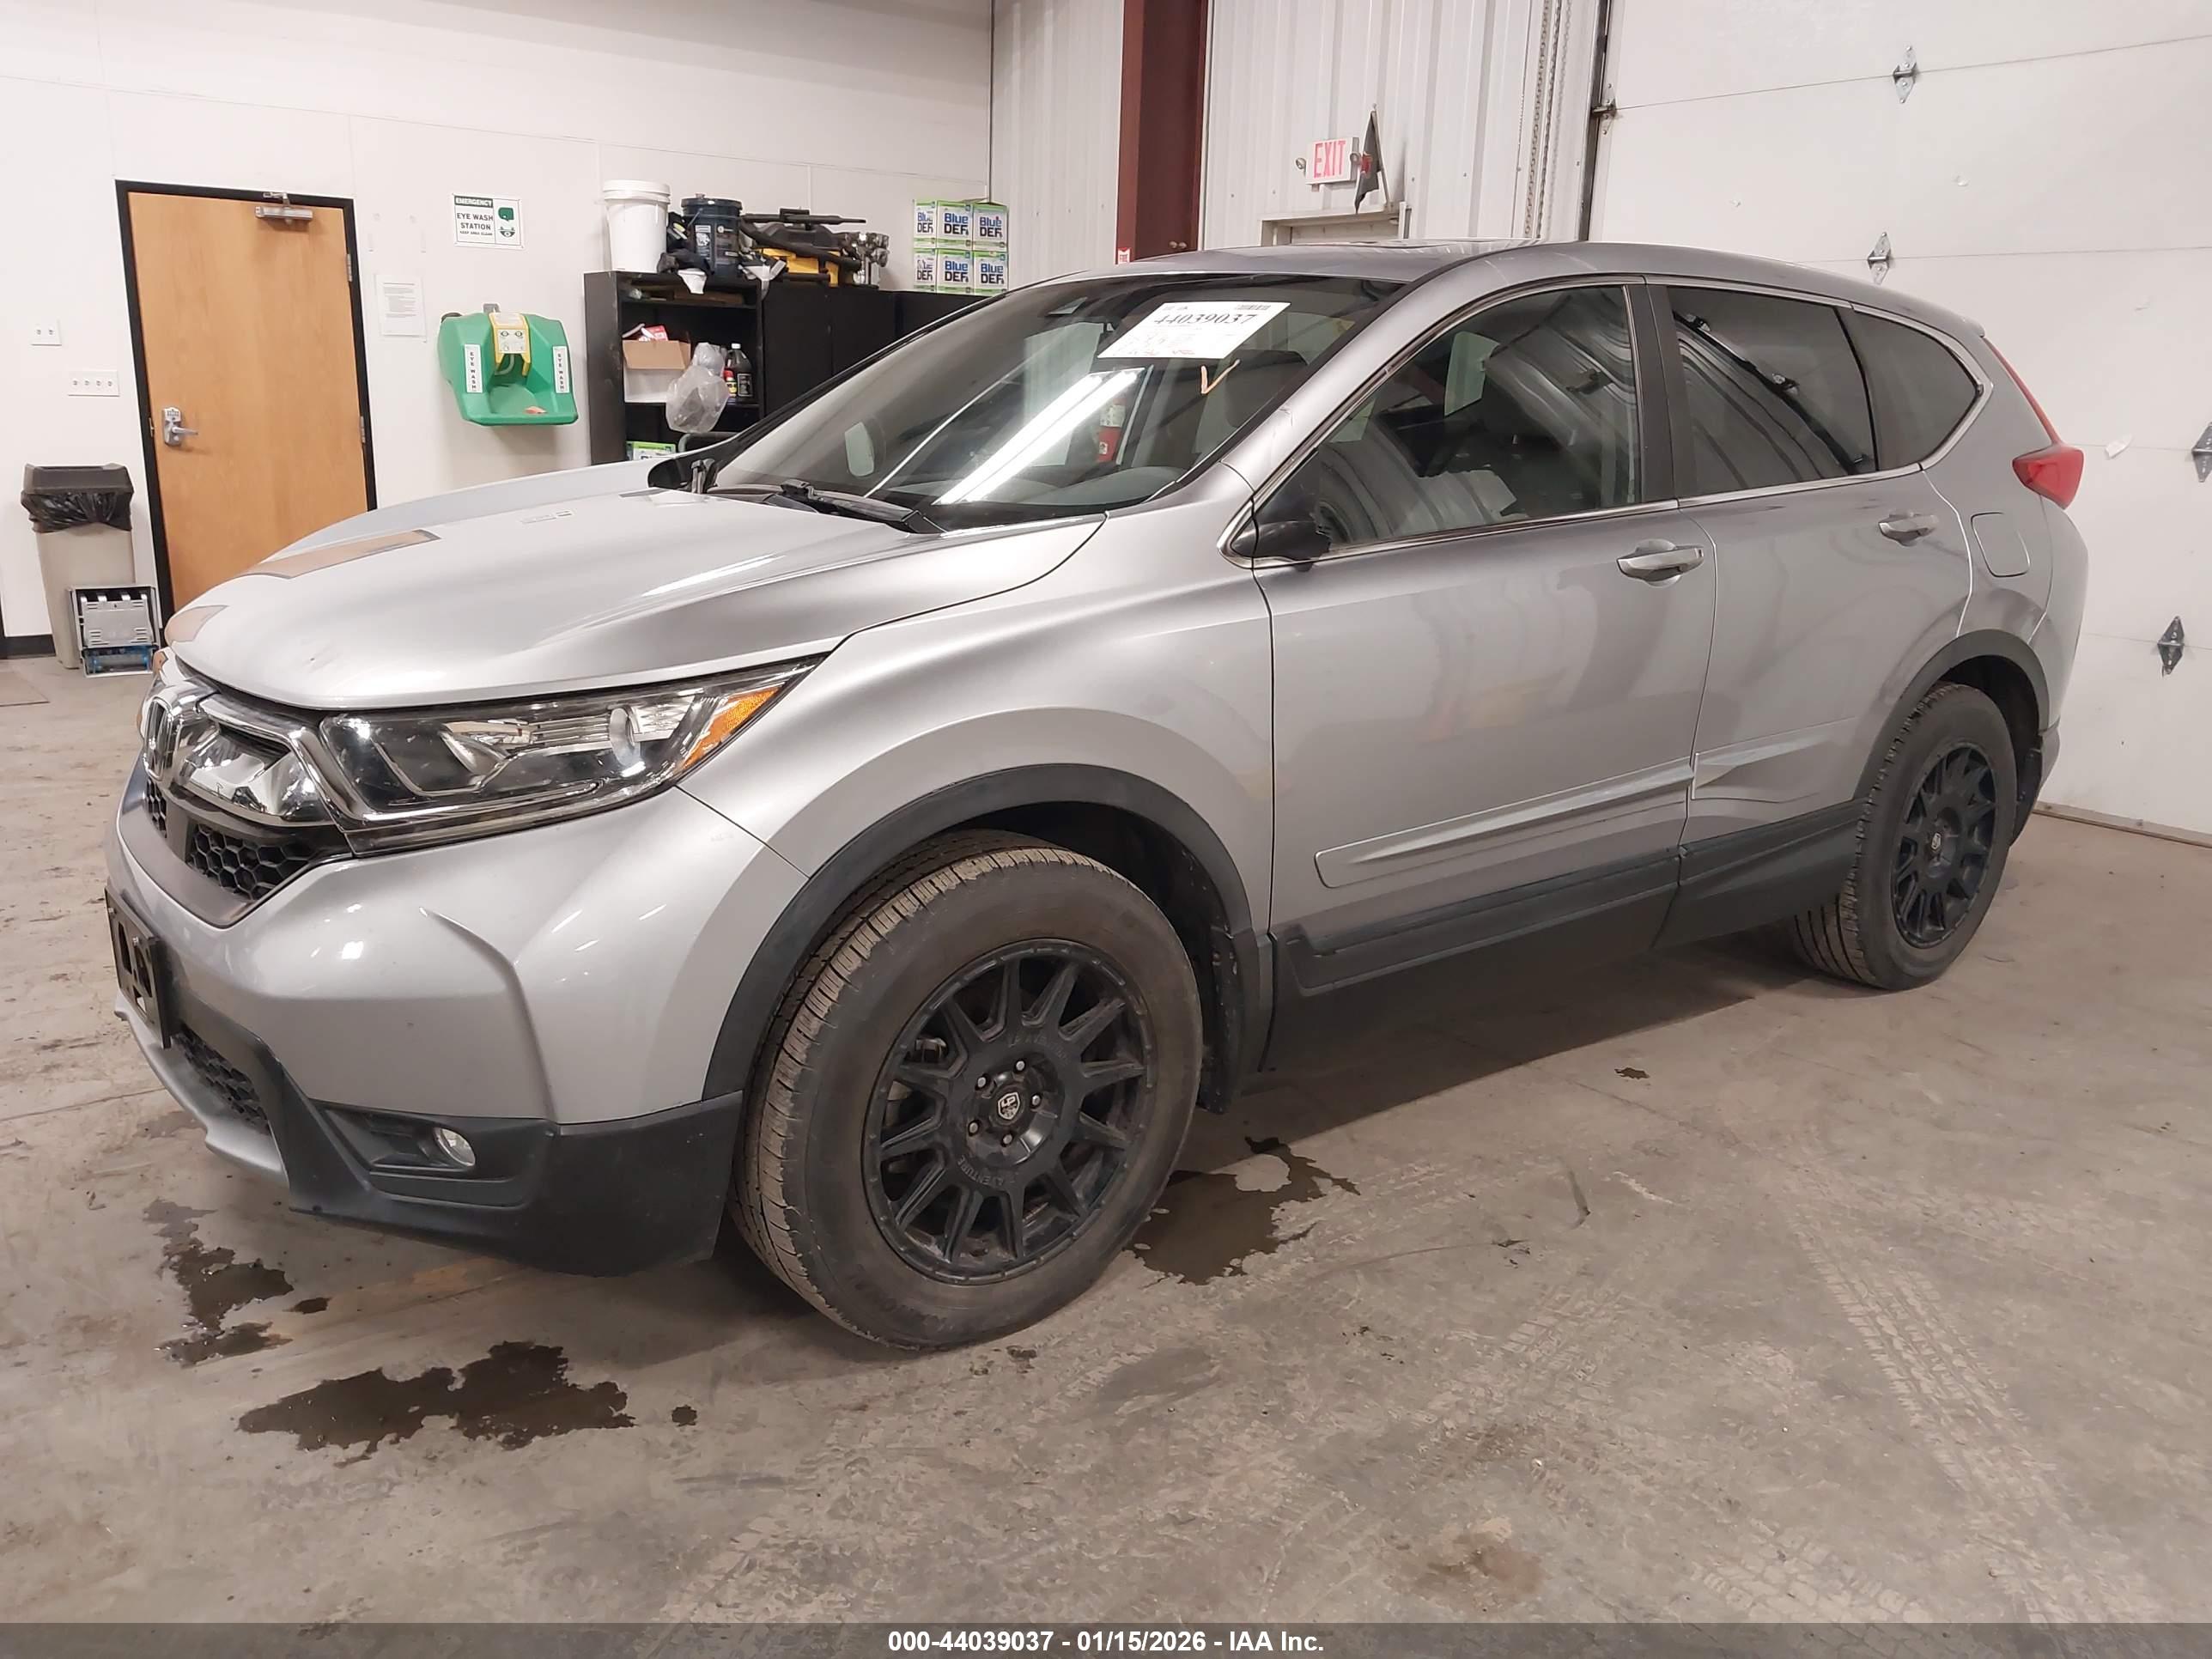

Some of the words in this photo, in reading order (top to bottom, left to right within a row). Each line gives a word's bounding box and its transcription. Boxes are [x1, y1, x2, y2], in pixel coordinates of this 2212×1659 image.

[1314, 140, 1346, 179] EXIT
[472, 213, 494, 222] WASH
[944, 213, 969, 223] Blue
[979, 216, 1002, 227] Blue
[460, 222, 491, 230] STATION
[917, 222, 933, 234] DEF
[944, 223, 969, 235] DEF
[979, 227, 1003, 238] DEF
[945, 260, 969, 271] Blue
[981, 263, 1004, 273] Blue
[917, 270, 933, 281] DEF
[945, 270, 969, 283] DEF
[981, 273, 1005, 284] DEF
[1154, 313, 1258, 325] 44039037
